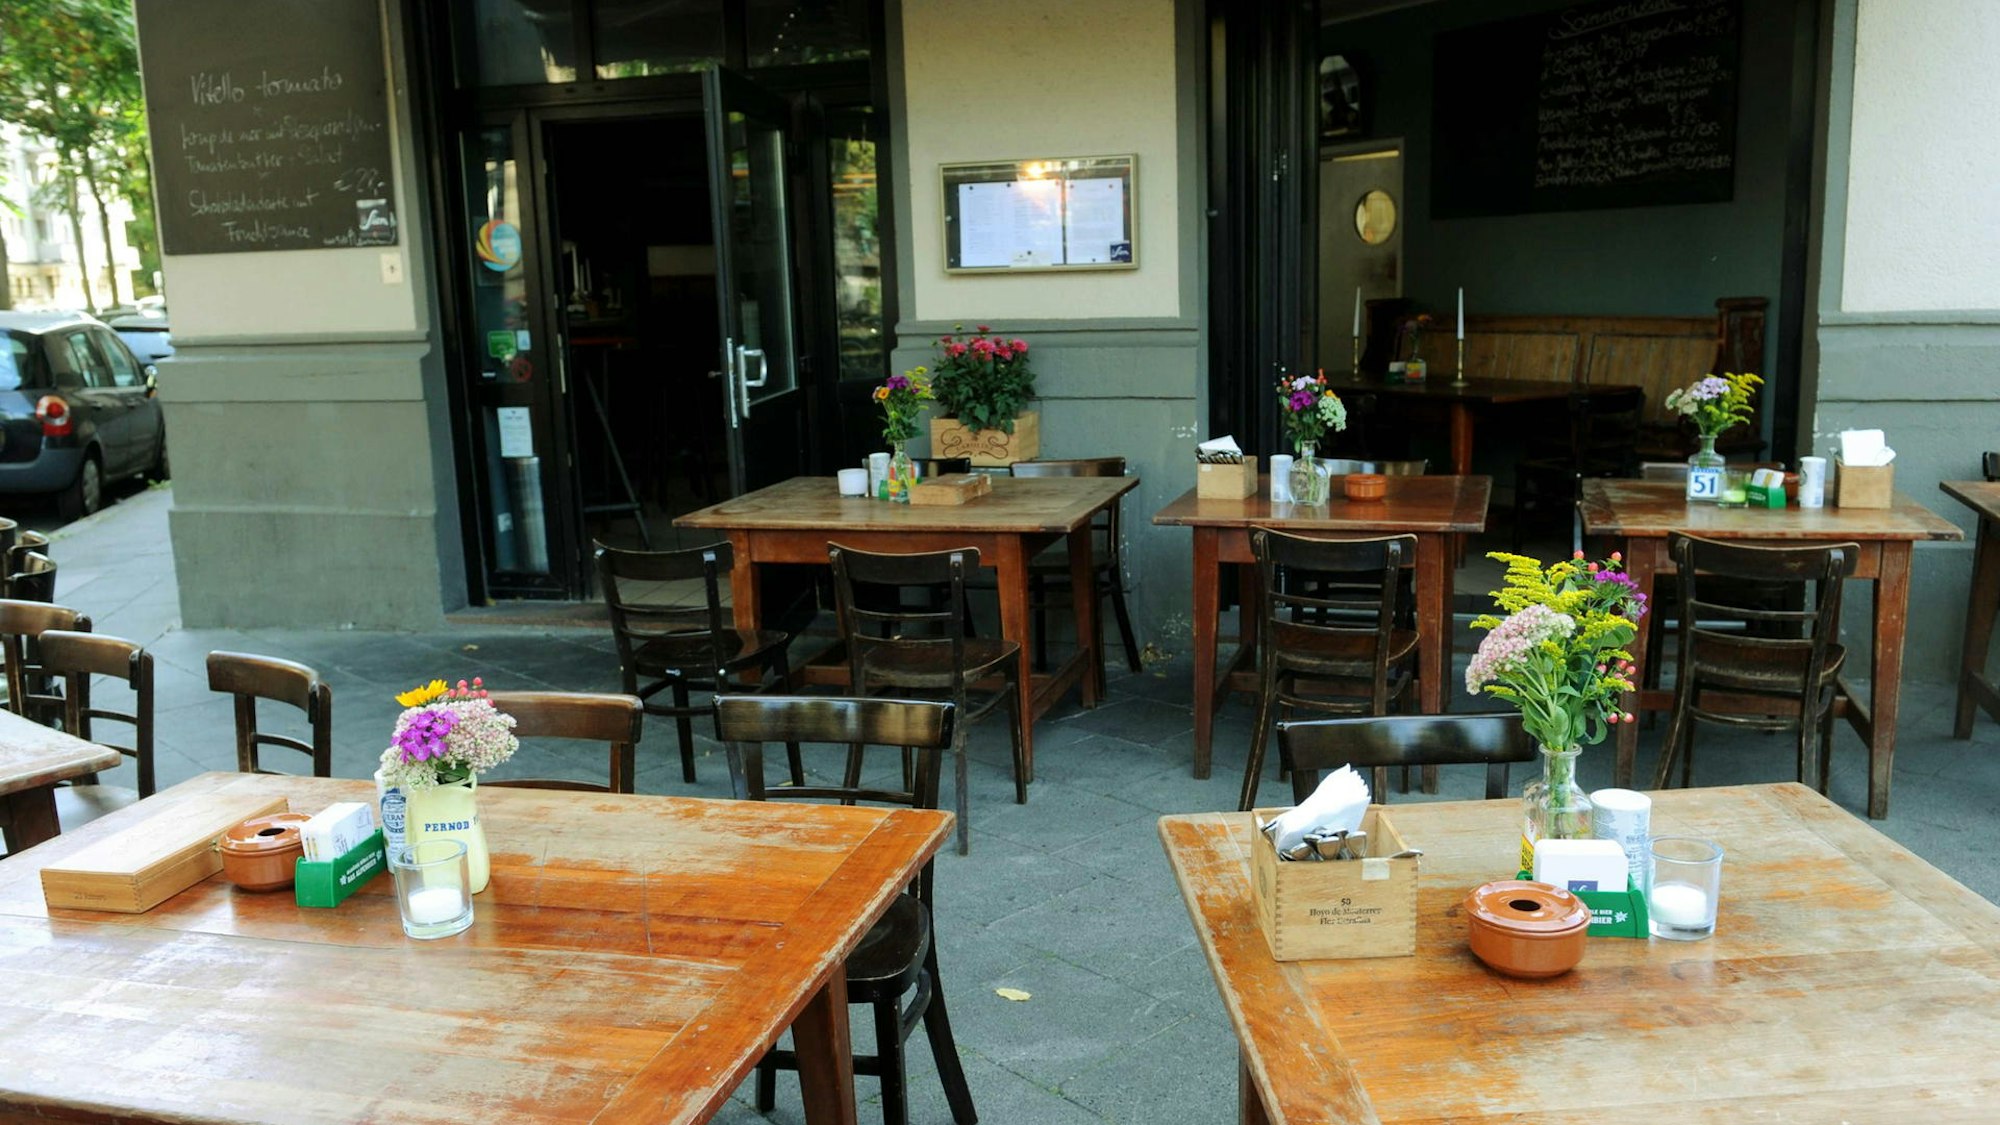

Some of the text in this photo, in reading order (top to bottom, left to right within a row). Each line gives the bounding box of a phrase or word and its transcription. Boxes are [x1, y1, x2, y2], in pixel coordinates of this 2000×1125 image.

[1694, 475, 1716, 495] 51
[424, 821, 470, 833] PERNOD
[1341, 898, 1351, 906] 50
